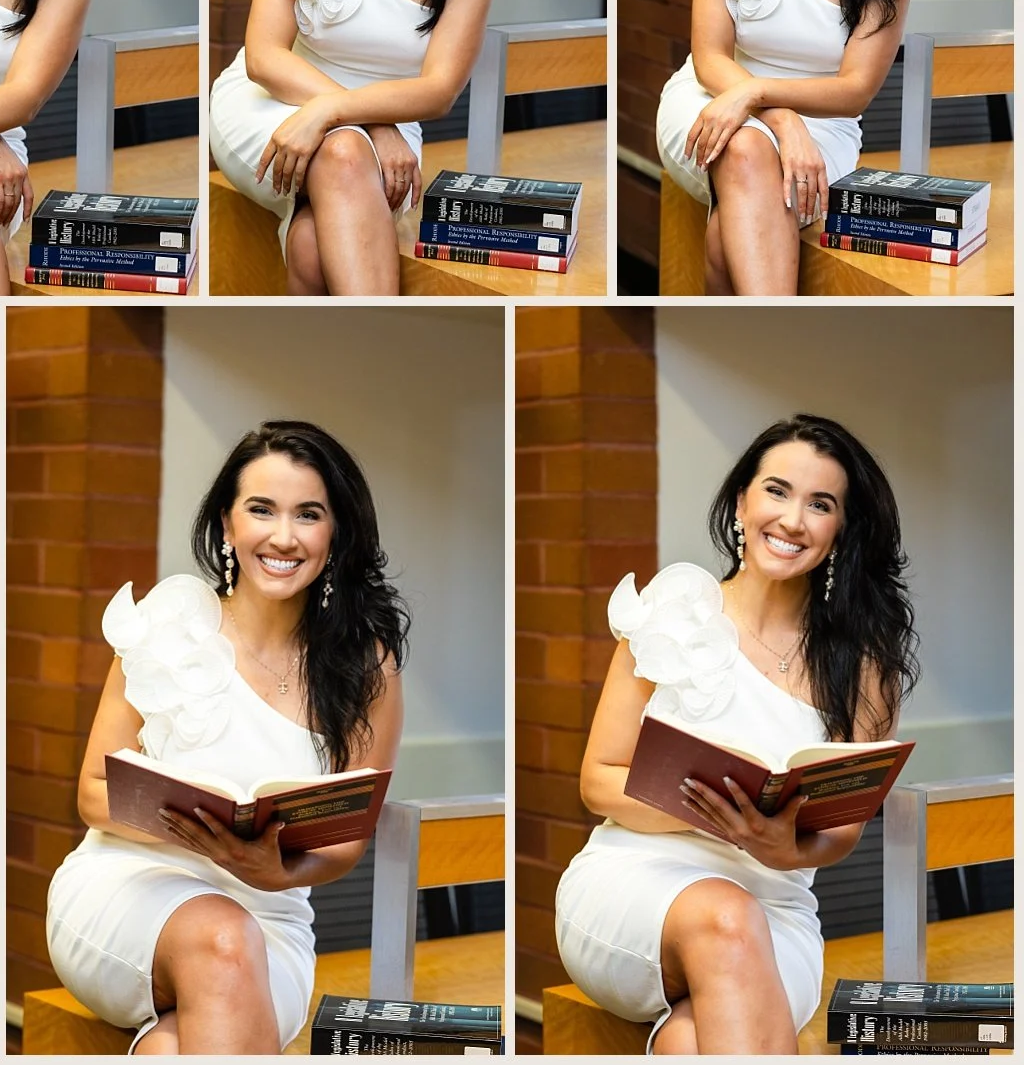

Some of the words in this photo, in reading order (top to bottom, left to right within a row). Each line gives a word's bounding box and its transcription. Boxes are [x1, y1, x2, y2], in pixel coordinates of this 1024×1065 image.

[448, 225, 490, 234] PROFESSIONAL
[492, 230, 538, 239] RESPONSIBILITY
[60, 248, 104, 257] PROFESSIONAL
[106, 251, 155, 260] RESPONSIBILITY
[860, 1016, 878, 1042] History
